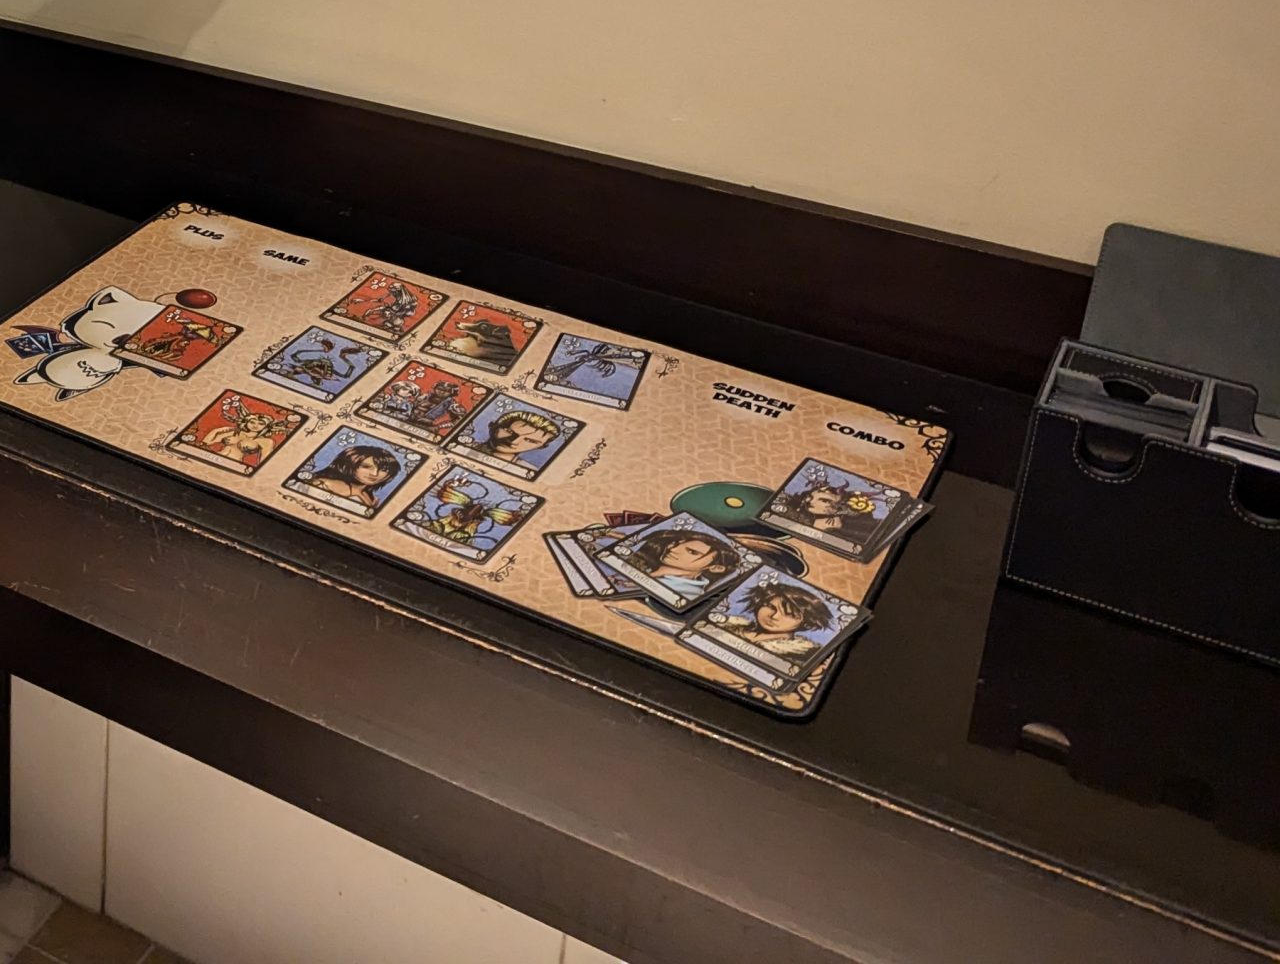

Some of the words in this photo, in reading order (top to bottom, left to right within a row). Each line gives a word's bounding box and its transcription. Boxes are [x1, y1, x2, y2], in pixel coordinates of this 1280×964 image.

[184, 224, 225, 241] PLUS
[263, 249, 311, 266] SAME
[712, 382, 797, 412] SUDDEN
[712, 392, 782, 419] DEATH
[826, 421, 905, 451] COMBO
